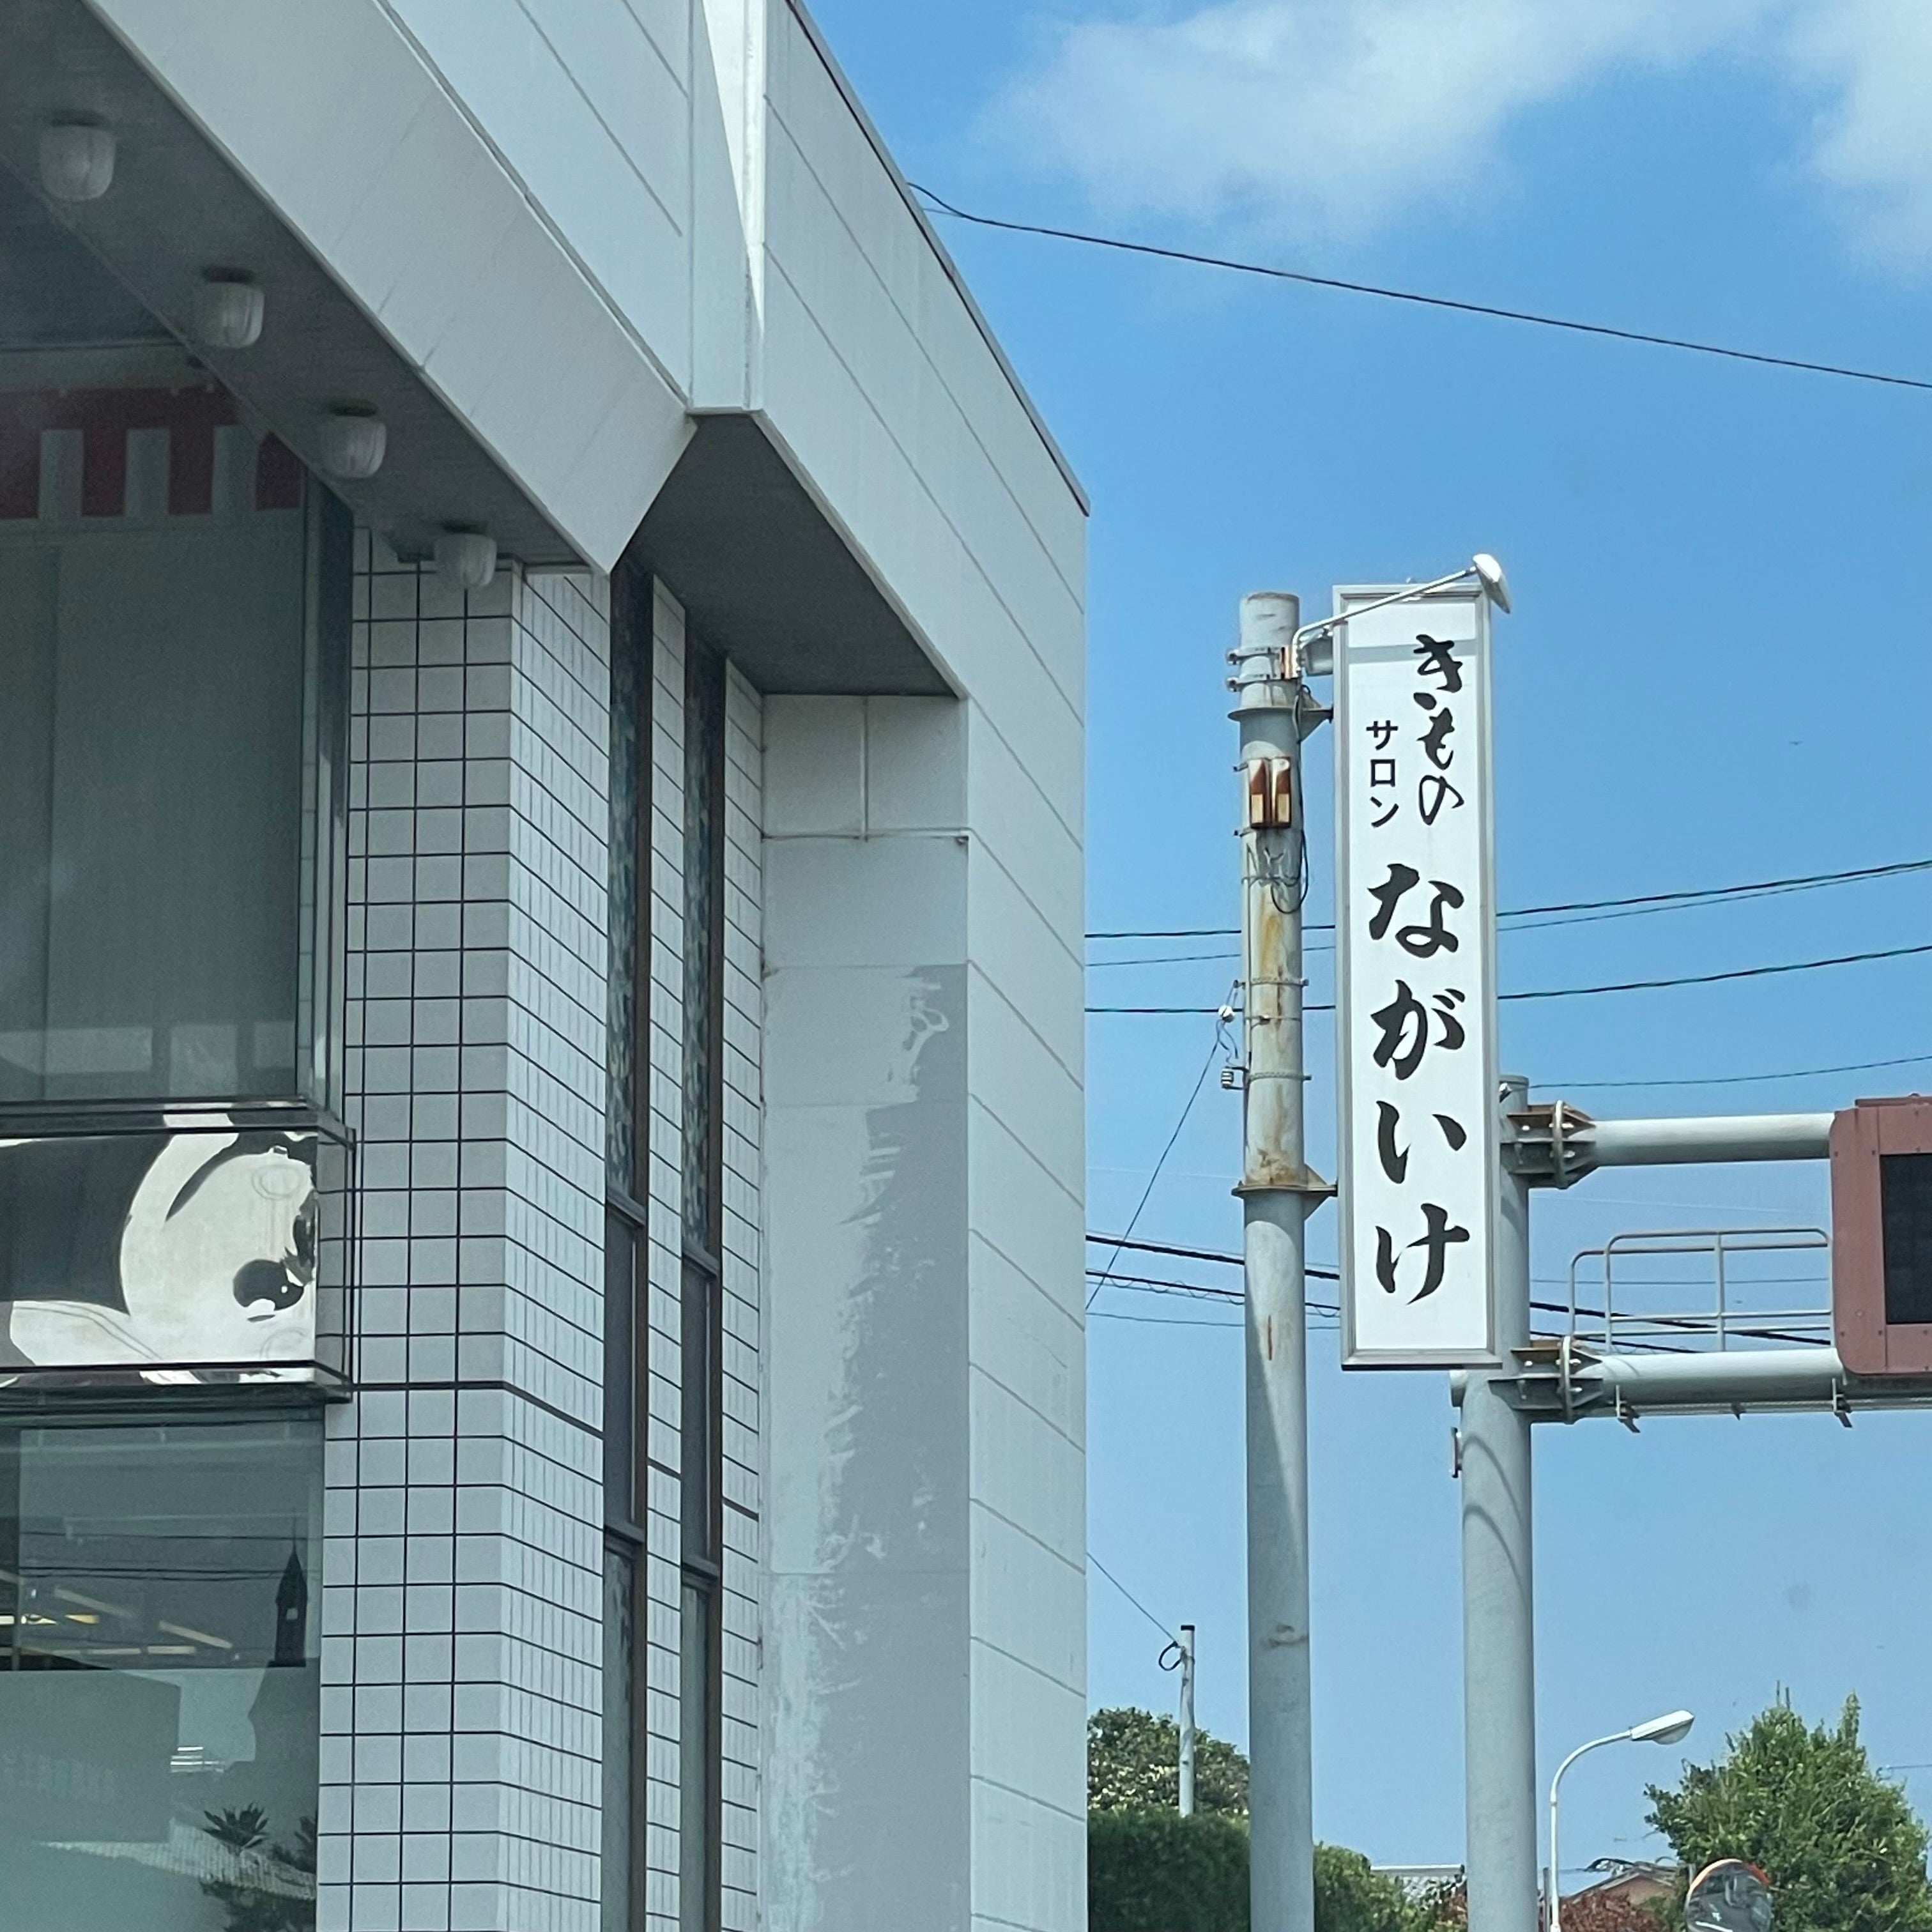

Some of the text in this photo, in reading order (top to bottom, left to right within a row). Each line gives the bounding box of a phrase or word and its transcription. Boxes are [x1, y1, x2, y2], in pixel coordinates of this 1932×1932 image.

[1366, 720, 1399, 828] サロン
[1413, 634, 1464, 825] きもの
[1367, 863, 1470, 1304] ながいけ
